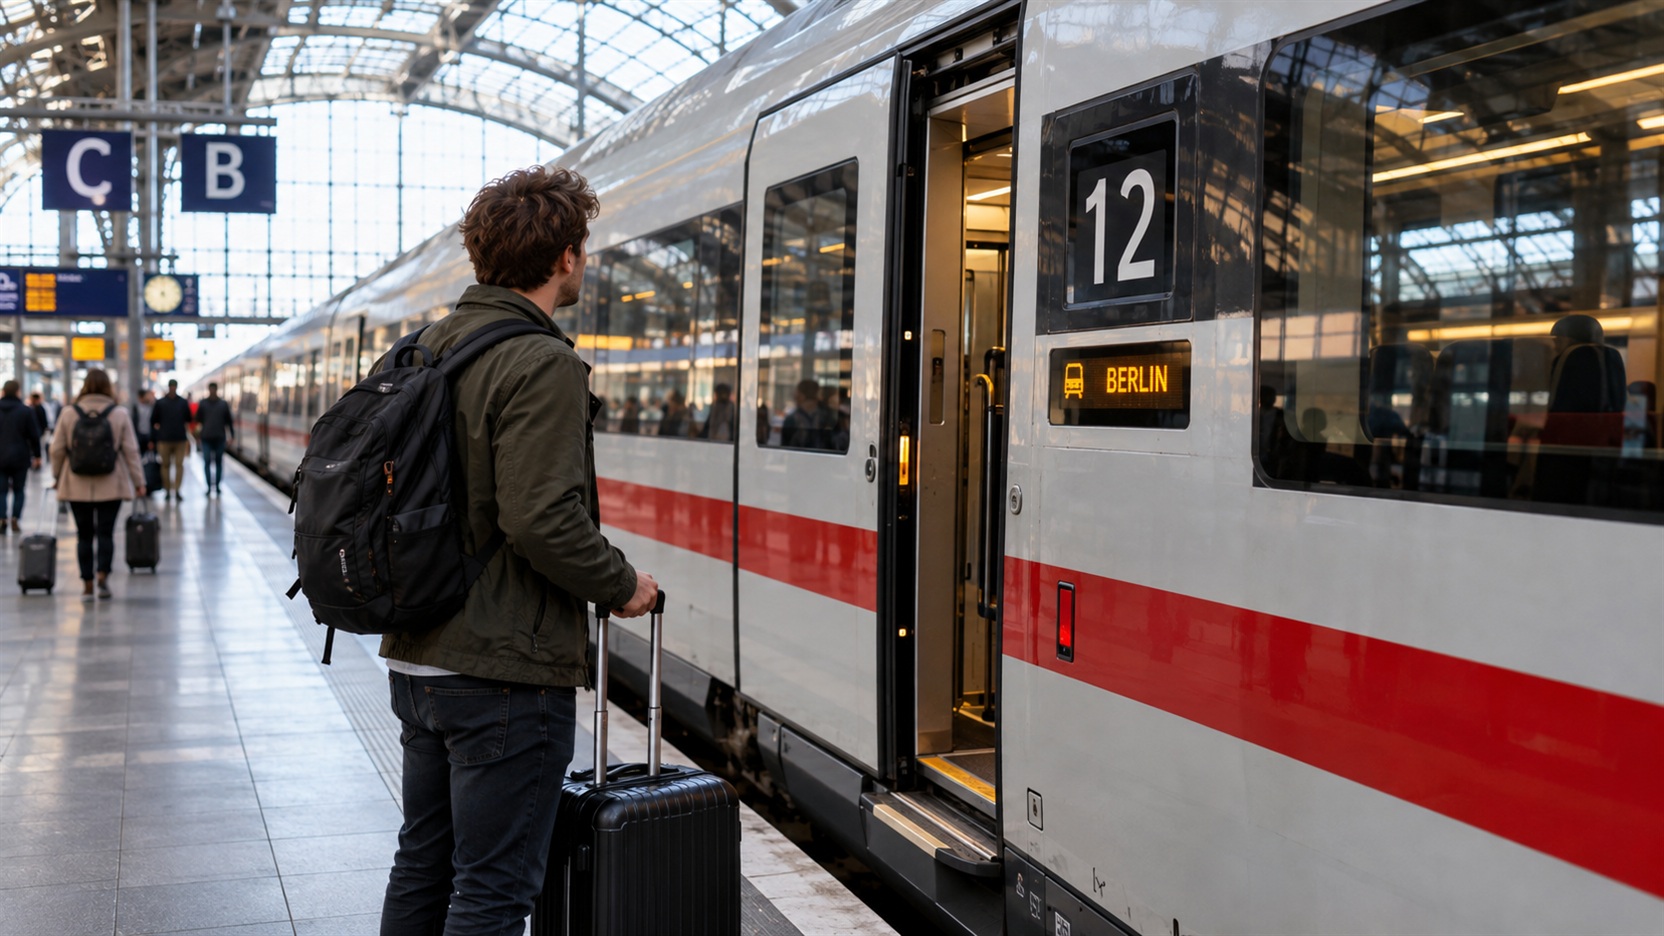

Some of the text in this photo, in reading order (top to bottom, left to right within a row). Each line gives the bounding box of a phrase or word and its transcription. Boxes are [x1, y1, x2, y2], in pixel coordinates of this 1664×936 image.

[206, 142, 245, 199] B
[1085, 168, 1155, 285] 12
[1106, 364, 1168, 394] BERLIN
